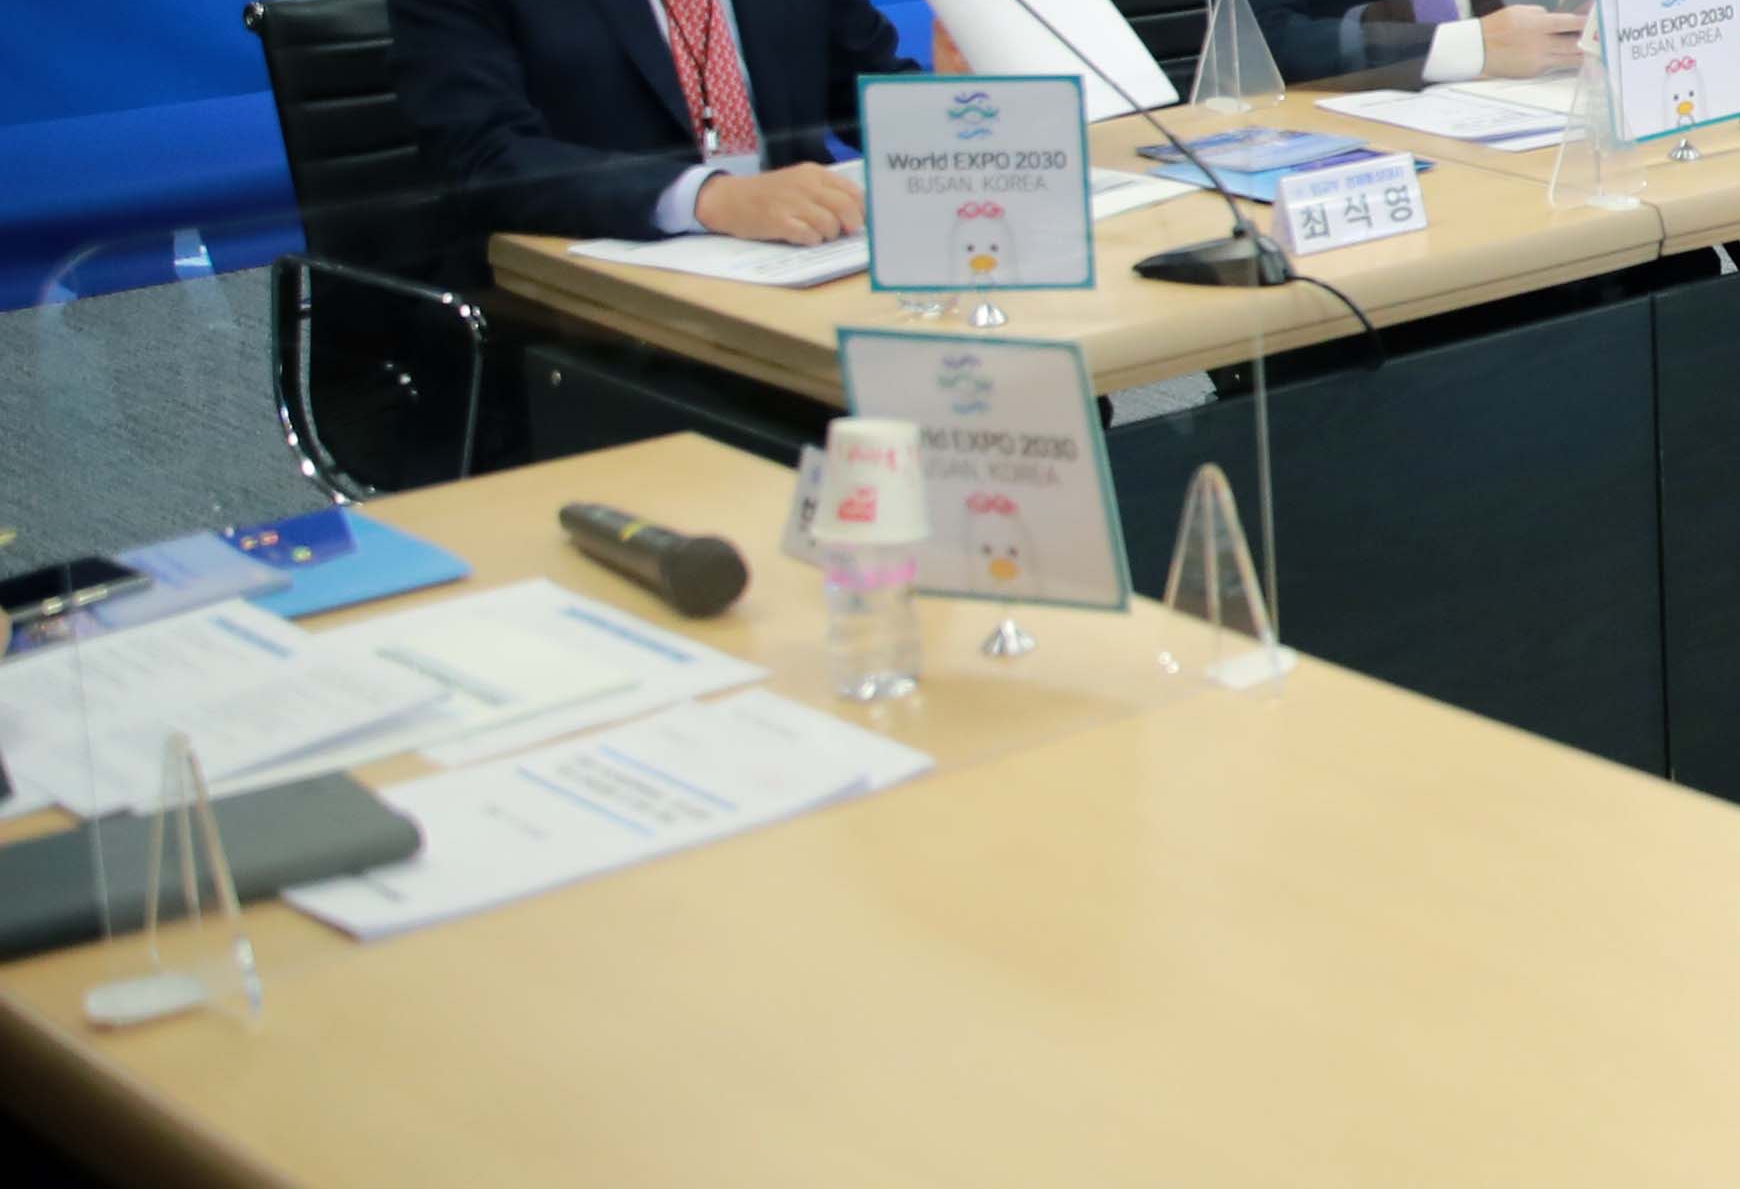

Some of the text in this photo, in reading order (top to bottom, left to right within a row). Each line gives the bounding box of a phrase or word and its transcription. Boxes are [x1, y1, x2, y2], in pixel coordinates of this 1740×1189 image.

[1617, 5, 1734, 43] World EXPO 2030
[1680, 27, 1723, 48] KOREA
[887, 150, 1067, 171] World EXPO 2030
[983, 174, 1049, 193] KOREA
[1301, 184, 1414, 241] 최석영
